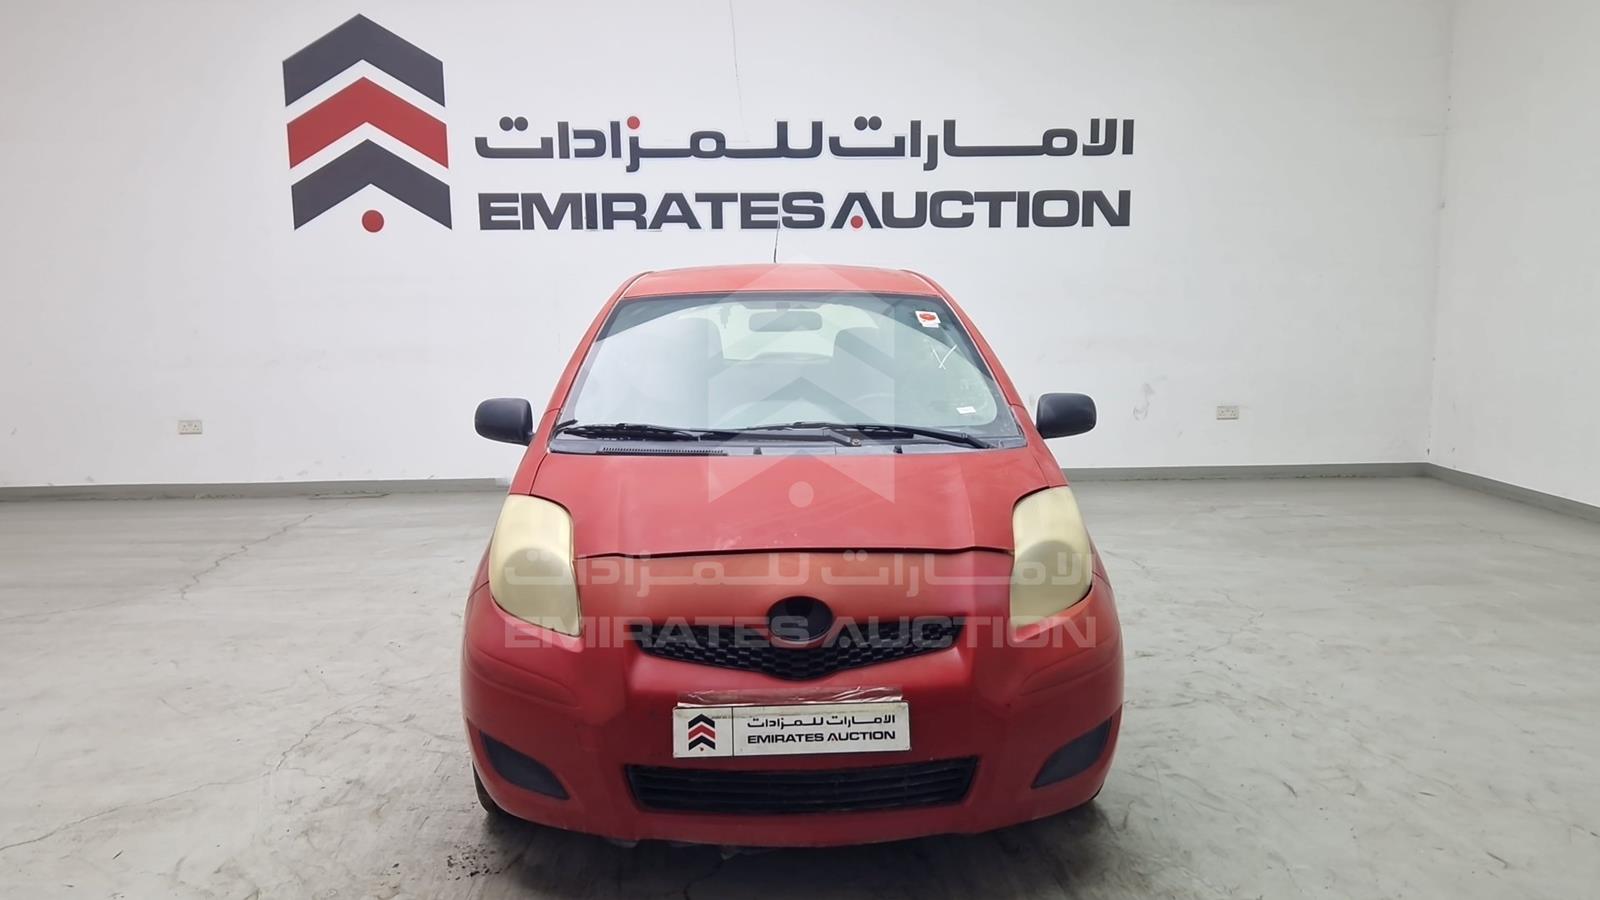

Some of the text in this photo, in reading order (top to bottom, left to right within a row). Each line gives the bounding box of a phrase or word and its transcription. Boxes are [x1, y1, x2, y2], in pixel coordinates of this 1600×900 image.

[475, 115, 1134, 172] الامارات للمزادات
[478, 190, 1131, 230] EMIRATES AUCTION
[747, 714, 896, 730] الامارات للمزادات
[747, 731, 896, 744] EMIRATES AUCTION
